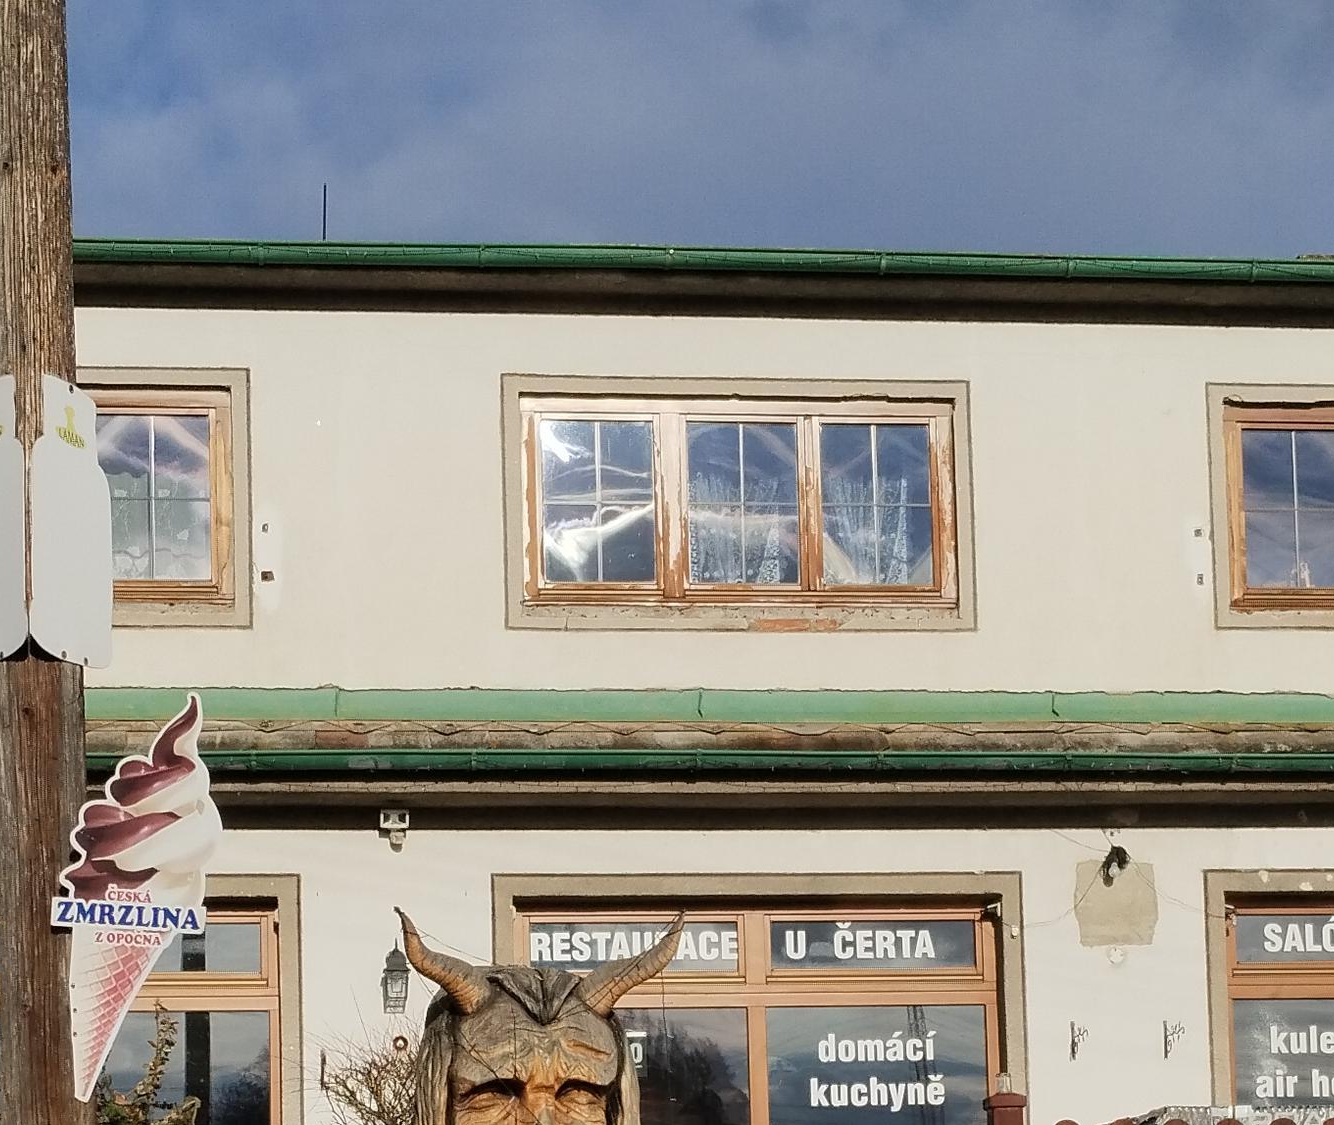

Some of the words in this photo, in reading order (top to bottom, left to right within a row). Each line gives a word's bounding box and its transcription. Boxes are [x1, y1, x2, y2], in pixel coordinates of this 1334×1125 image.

[107, 886, 152, 903] ČESKÁ
[56, 900, 201, 930] ZMRZLINA
[94, 931, 104, 943] Z
[106, 931, 162, 946] OPOČNA
[784, 930, 807, 959] U
[833, 922, 937, 960] ČERTA
[817, 1031, 937, 1063] domácí
[809, 1075, 946, 1113] kuchyně
[1255, 1069, 1298, 1099] air
